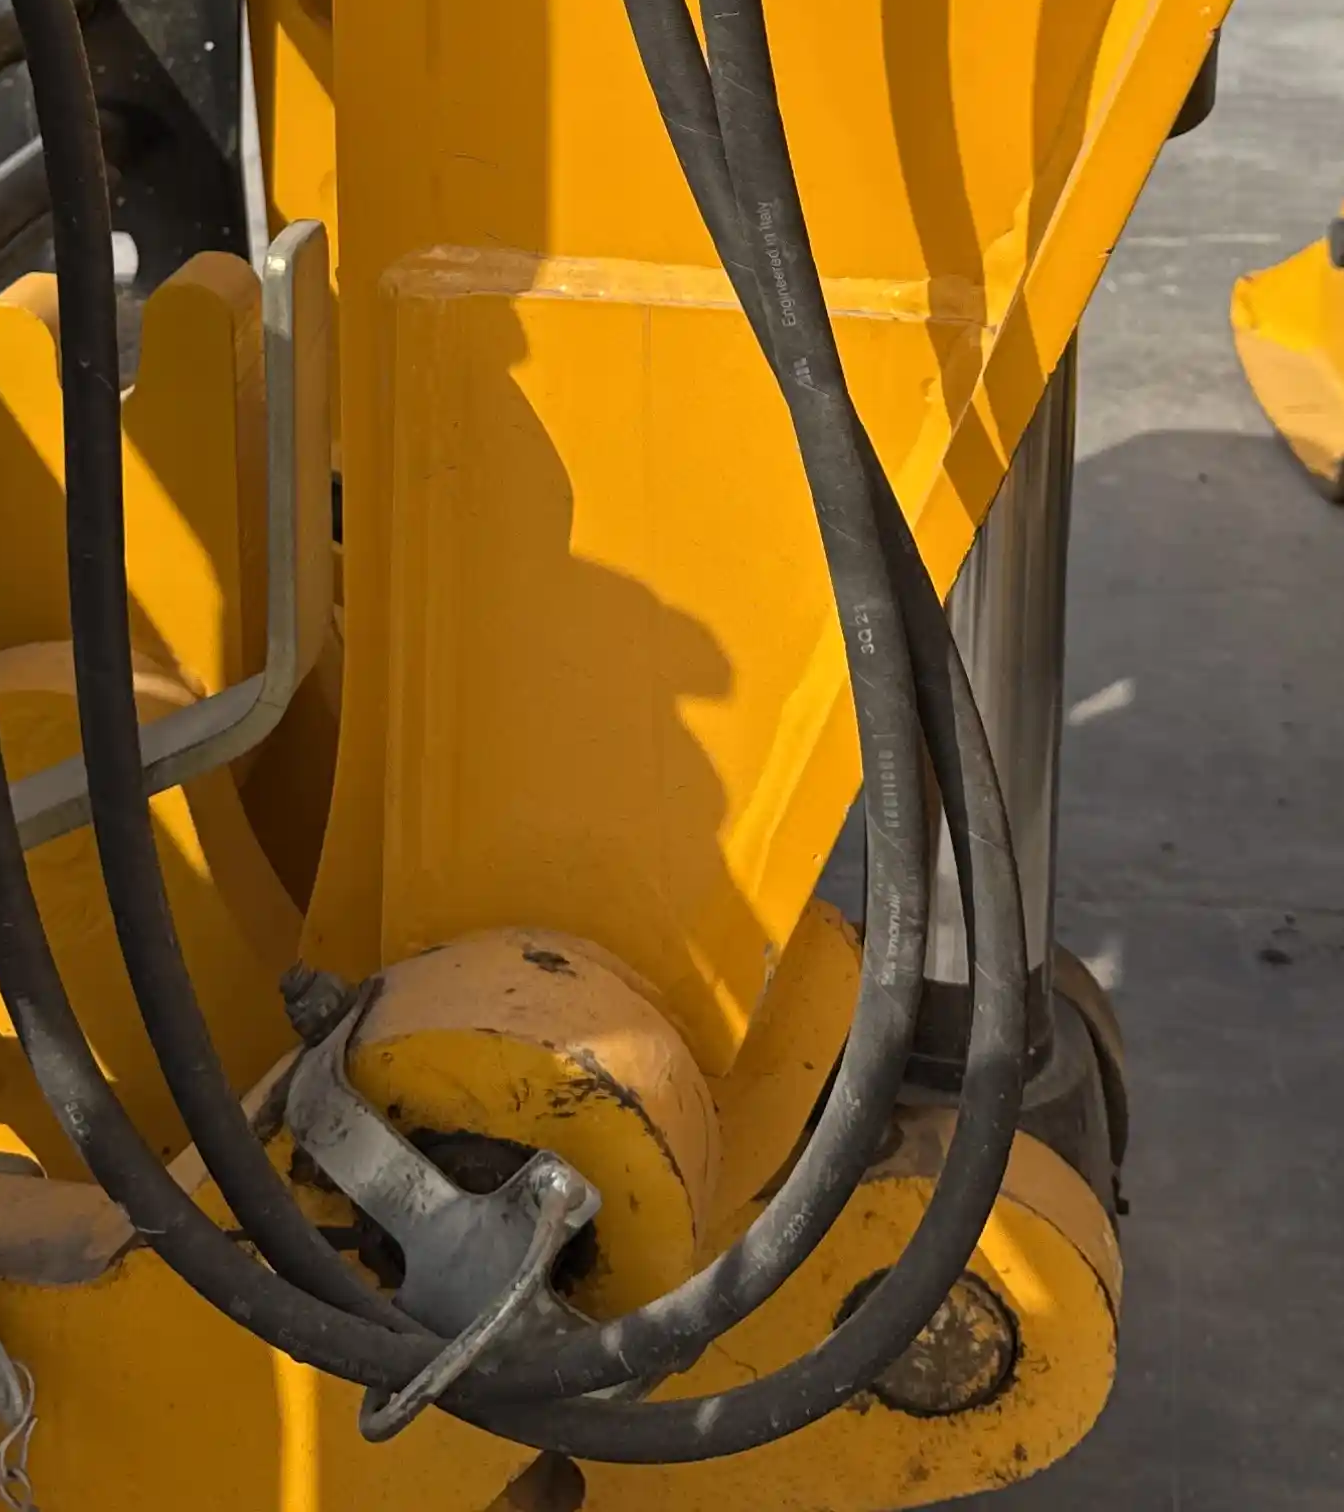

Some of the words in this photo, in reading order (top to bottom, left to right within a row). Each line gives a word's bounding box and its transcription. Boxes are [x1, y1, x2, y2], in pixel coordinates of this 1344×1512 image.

[757, 201, 773, 231] Italy
[763, 232, 776, 247] in
[765, 248, 796, 327] Engineered
